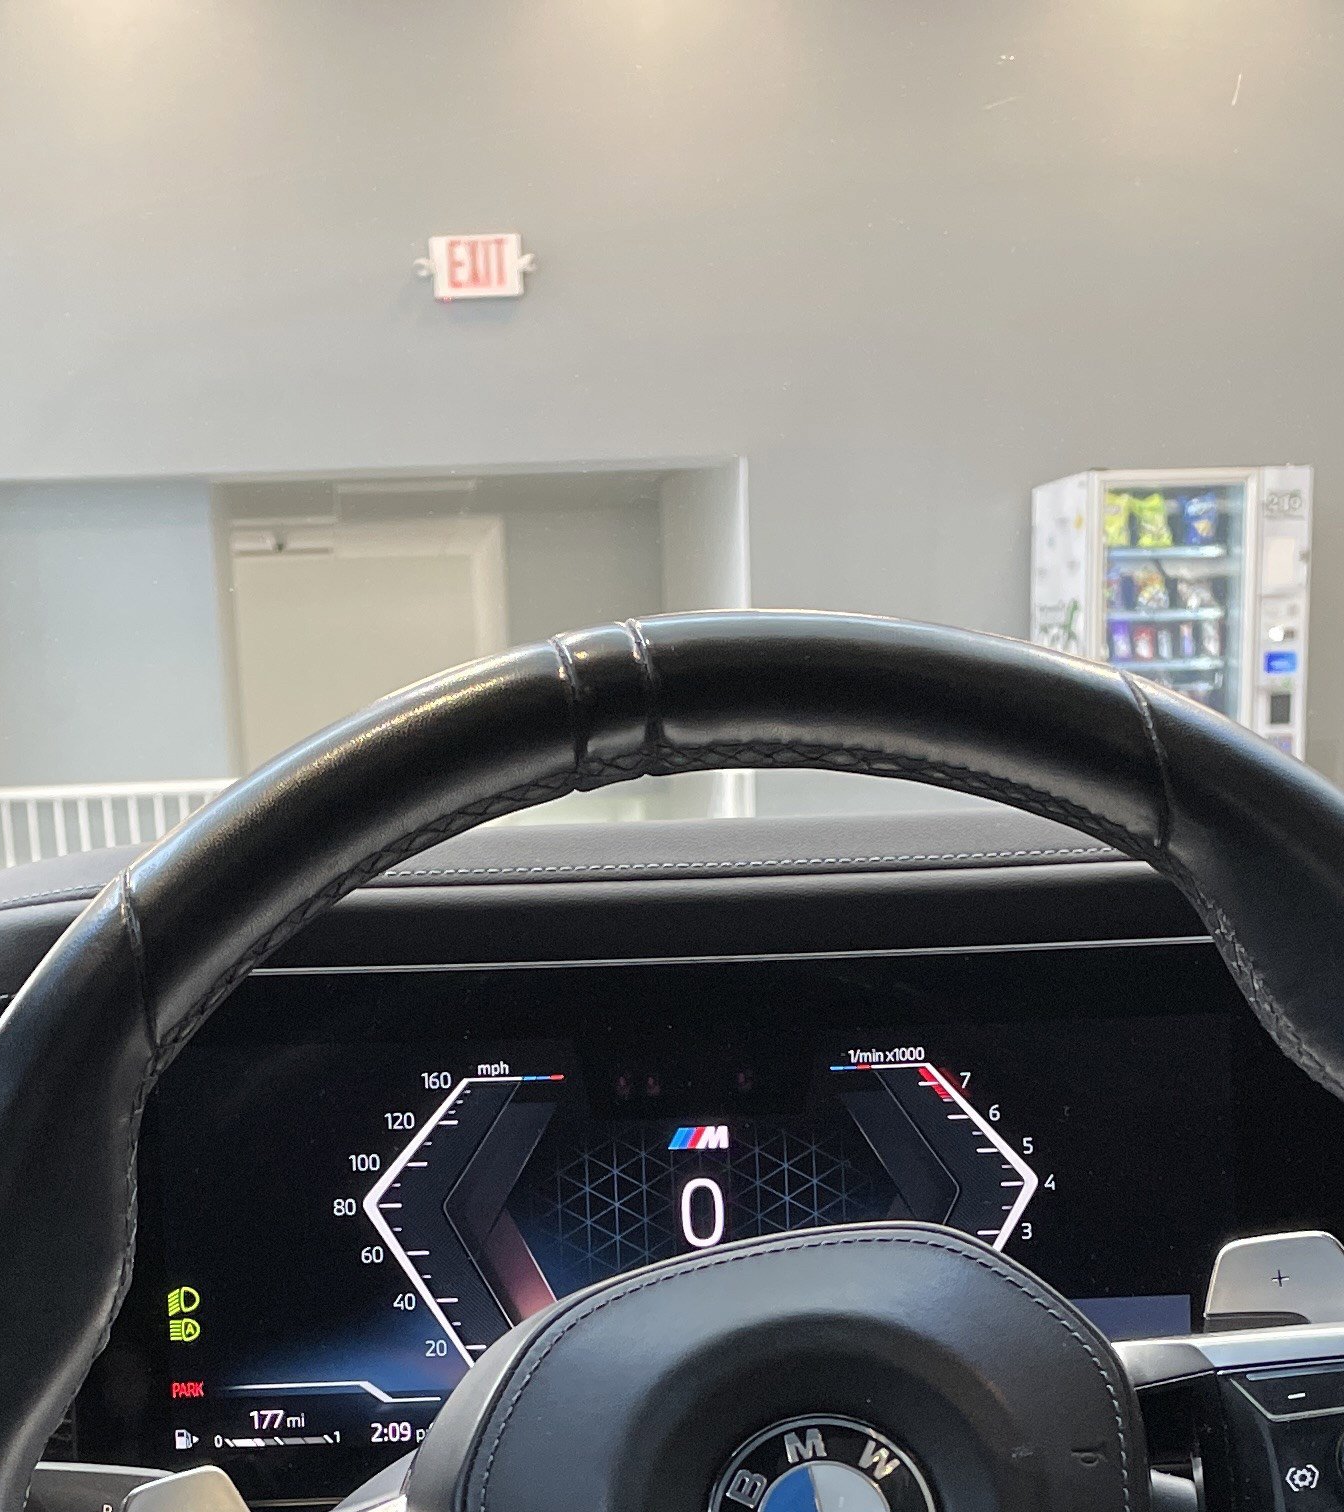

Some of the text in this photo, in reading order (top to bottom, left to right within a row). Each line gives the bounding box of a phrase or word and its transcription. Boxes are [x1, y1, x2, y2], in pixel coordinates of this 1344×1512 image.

[447, 239, 507, 288] EXIT
[848, 1047, 925, 1063] 1/min x1000
[477, 1061, 509, 1077] mph
[421, 1072, 452, 1090] 160
[959, 1072, 971, 1089] 7
[384, 1112, 415, 1130] 120
[988, 1104, 1001, 1121] 6
[1022, 1137, 1034, 1155] 5
[348, 1154, 380, 1172] 100
[1044, 1174, 1056, 1191] 4
[333, 1198, 357, 1216] 80
[681, 1177, 725, 1248] 0
[1021, 1222, 1033, 1240] 3
[361, 1246, 384, 1263] 60
[393, 1293, 416, 1310] 40
[425, 1339, 448, 1357] 20
[172, 1381, 205, 1398] PARK
[249, 1409, 305, 1430] 177 mi
[333, 1431, 341, 1443] 1
[370, 1421, 412, 1443] 2:09
[213, 1435, 223, 1448] 0
[726, 1428, 900, 1509] BMW
